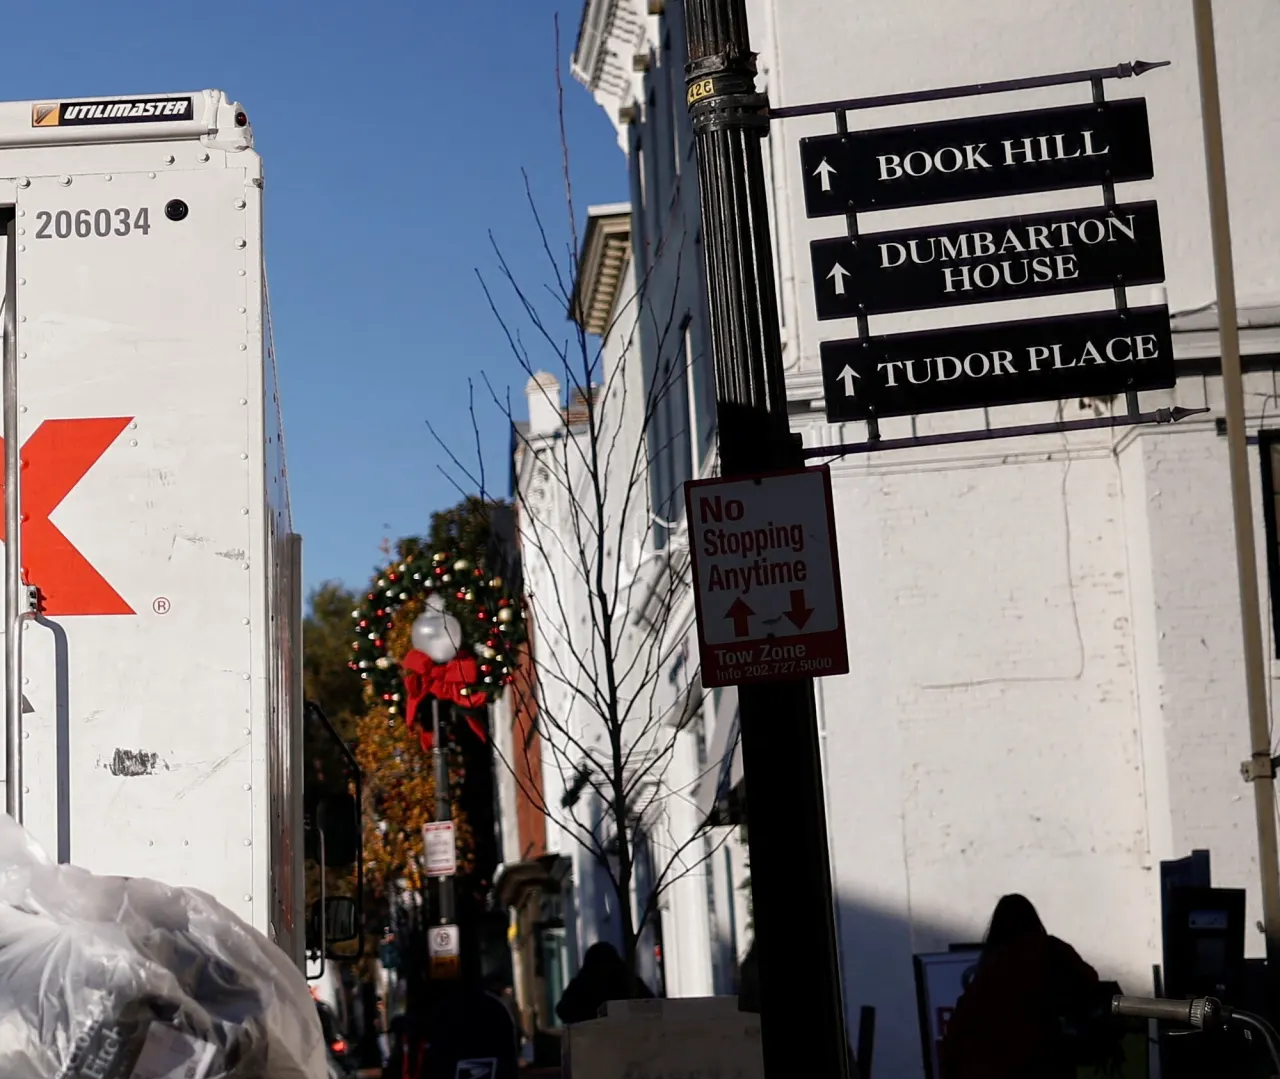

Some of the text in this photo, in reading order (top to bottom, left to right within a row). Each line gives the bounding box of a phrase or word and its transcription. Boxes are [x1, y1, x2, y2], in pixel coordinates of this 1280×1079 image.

[64, 101, 188, 119] UTILIMASTER
[877, 130, 1109, 180] BOOK HILL
[35, 208, 151, 239] 206034
[878, 214, 1136, 269] DUMBARTON
[942, 254, 1079, 293] HOUSE
[877, 335, 1158, 388] TUDOR PLACE
[700, 496, 744, 524] No
[704, 521, 804, 558] Stopping
[708, 558, 807, 594] Anytime
[715, 644, 806, 666] Tow Zone
[717, 667, 741, 681] Info
